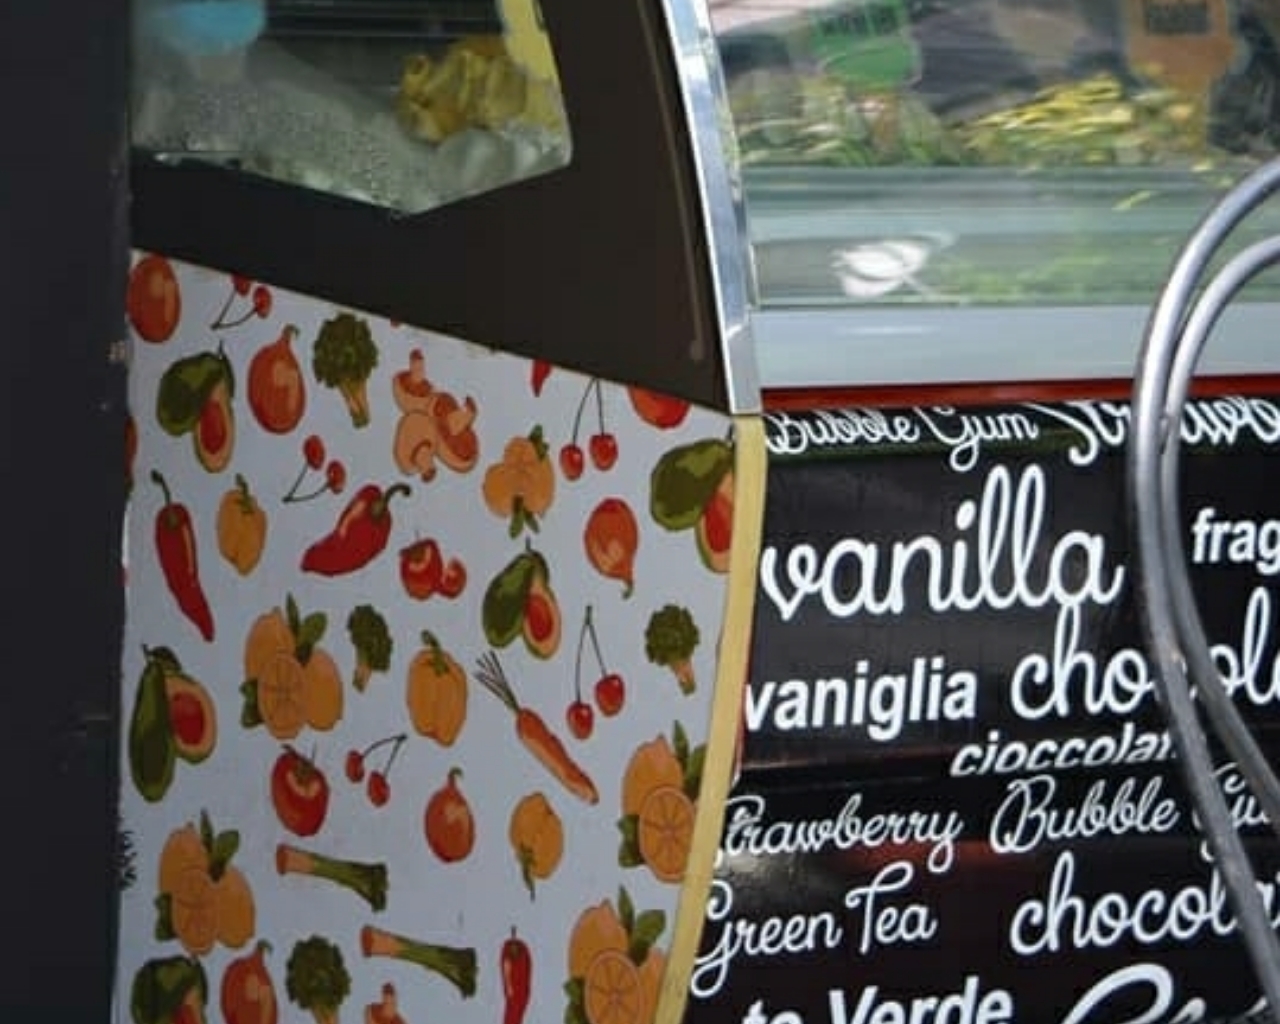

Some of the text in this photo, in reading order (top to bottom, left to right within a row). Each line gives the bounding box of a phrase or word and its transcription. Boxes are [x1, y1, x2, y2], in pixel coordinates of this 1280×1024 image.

[761, 464, 1125, 620] vanilla
[1192, 507, 1280, 576] frag
[745, 658, 977, 740] vaniglia
[989, 775, 1181, 854] Bubble
[690, 861, 938, 998] Green Tea
